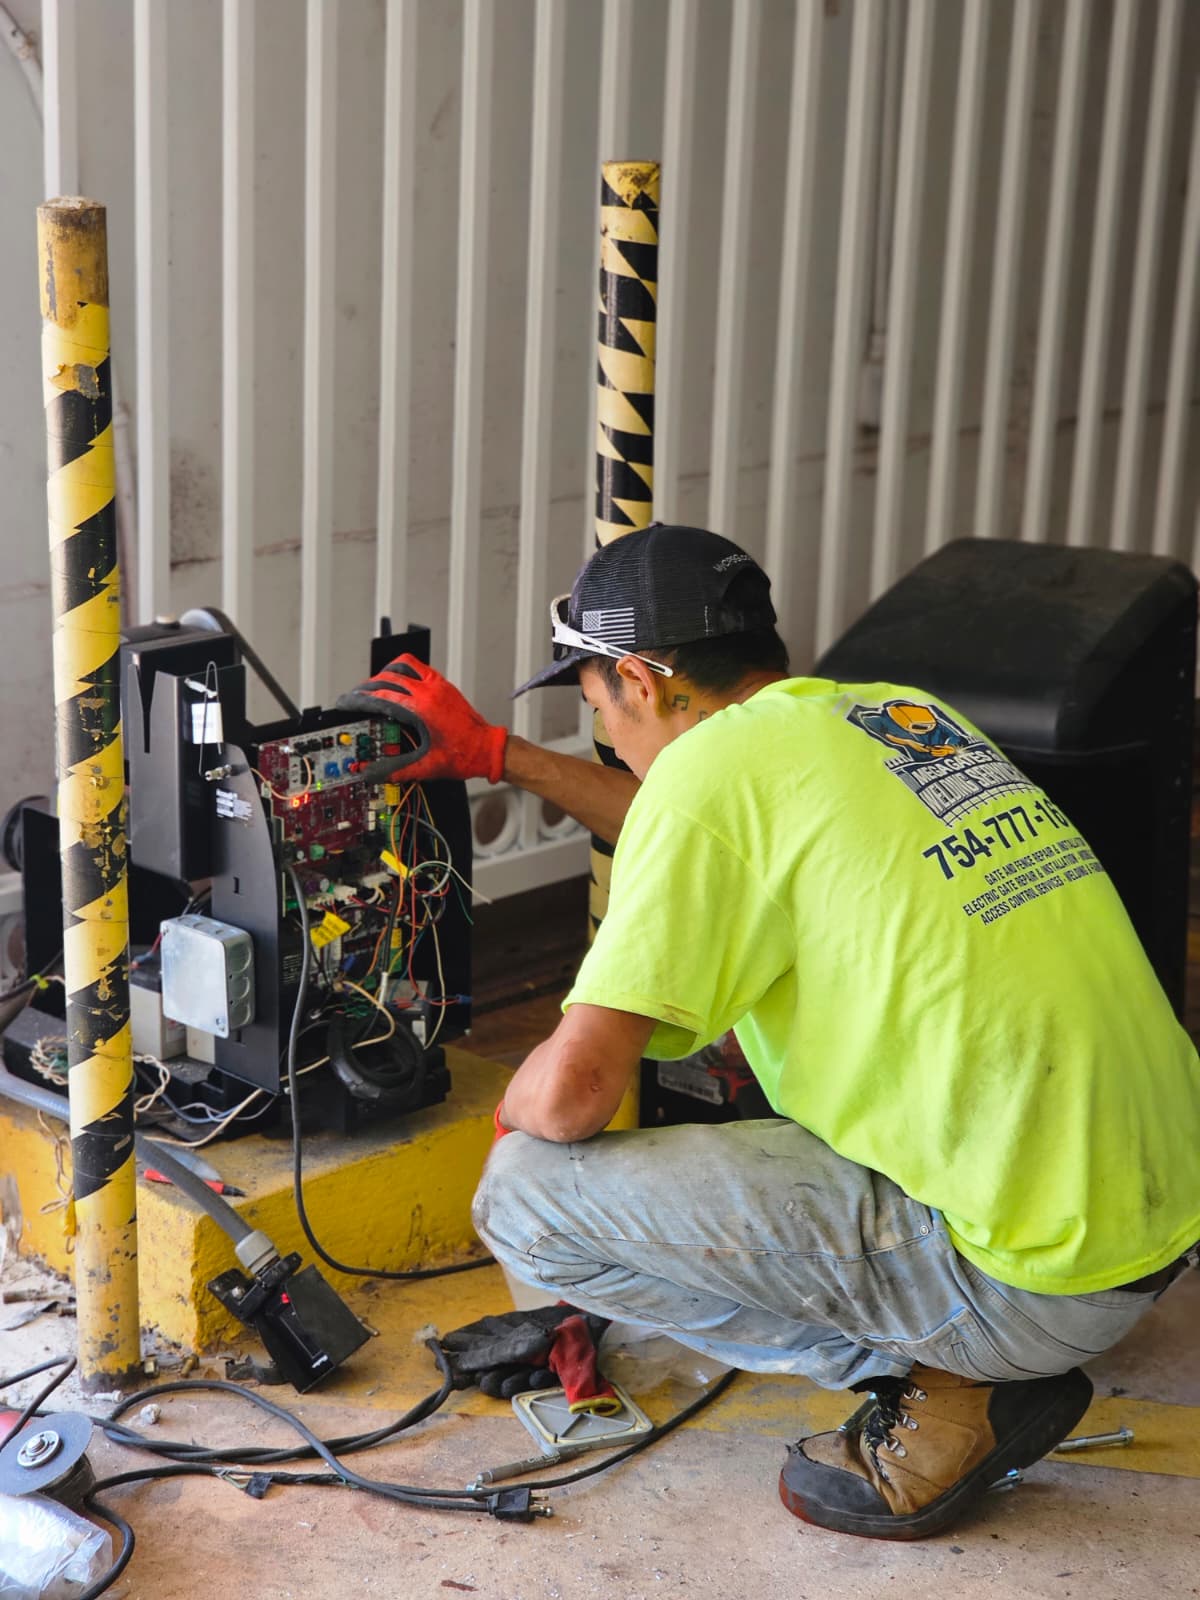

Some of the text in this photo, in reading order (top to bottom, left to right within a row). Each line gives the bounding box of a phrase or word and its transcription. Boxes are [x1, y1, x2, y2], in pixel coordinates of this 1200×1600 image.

[911, 763, 954, 786] MEGA
[944, 750, 989, 771] GATES
[918, 772, 981, 816] WELDING
[984, 869, 1005, 886] GATE
[1002, 863, 1018, 876] AND
[1014, 855, 1036, 870] FENCE
[1032, 846, 1055, 862] REPAIR
[962, 889, 1000, 916] ELECTRIC
[997, 880, 1018, 896] GATE
[1015, 870, 1038, 887] REPAIR
[980, 901, 1011, 925] ACCESS
[1008, 887, 1039, 908] CONTROL
[1035, 875, 1064, 895] SERVICES
